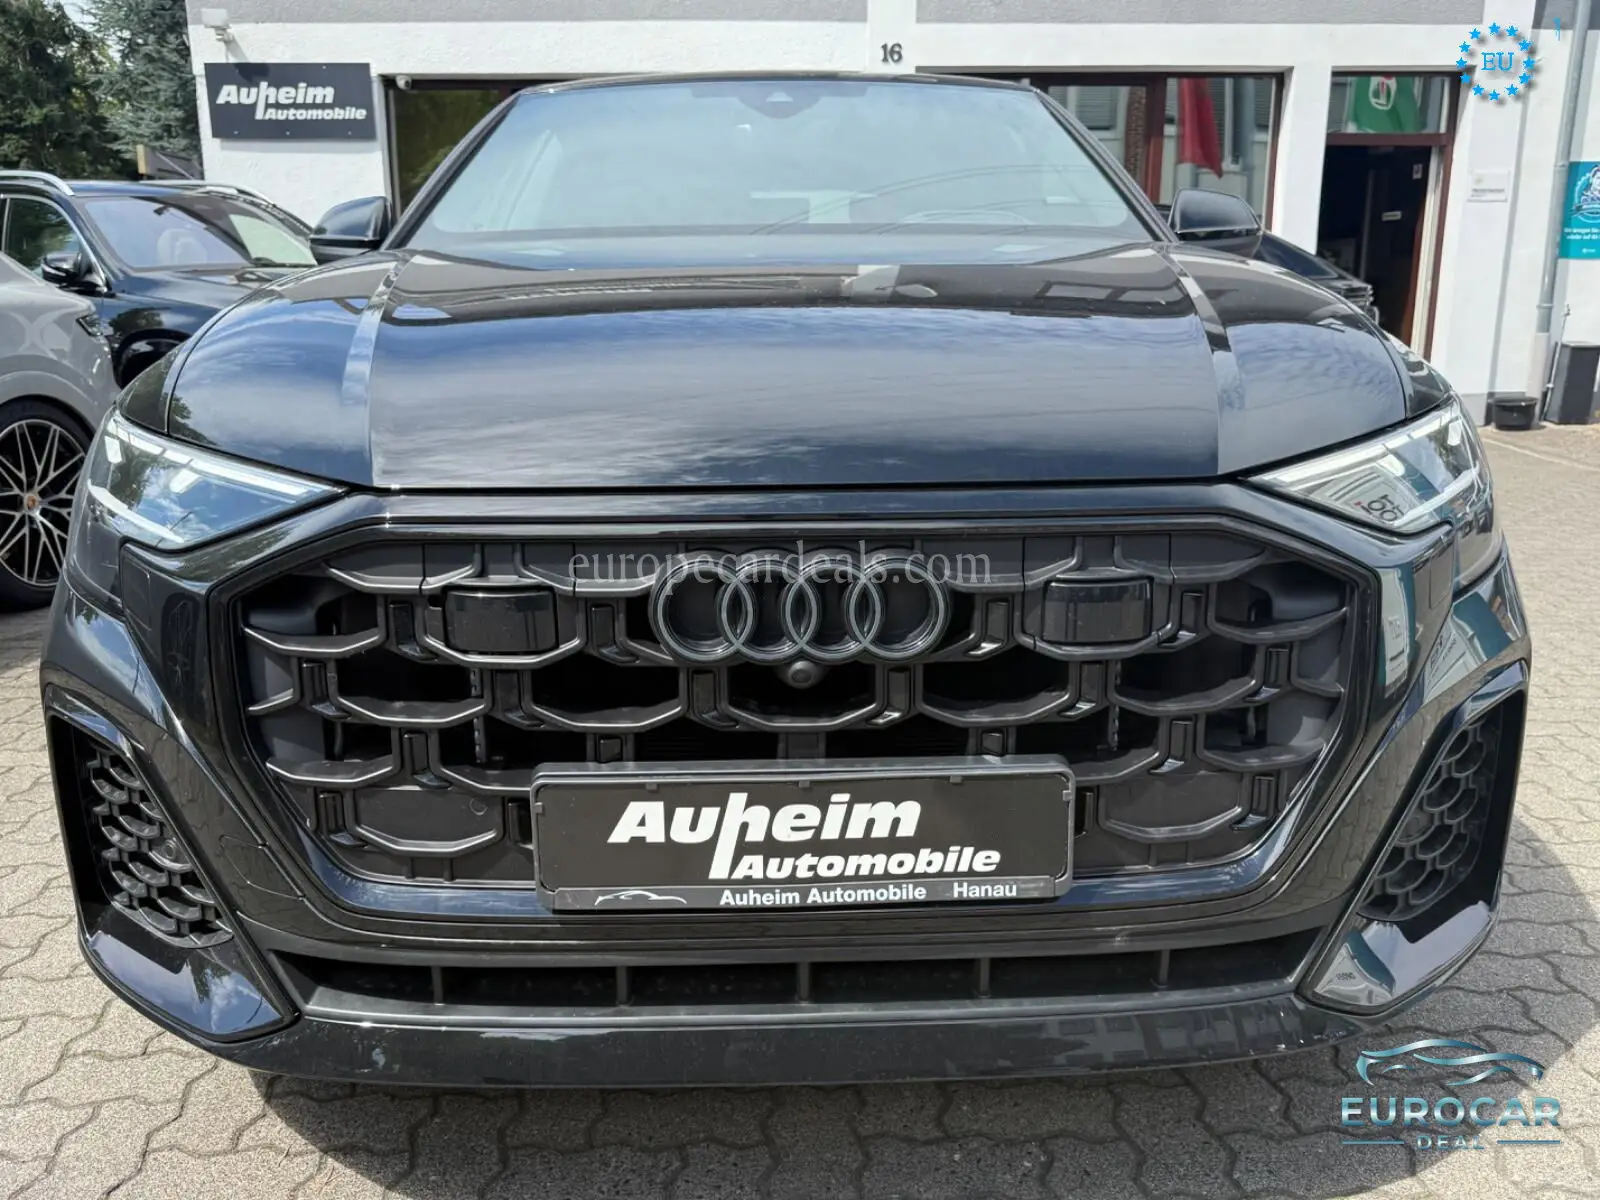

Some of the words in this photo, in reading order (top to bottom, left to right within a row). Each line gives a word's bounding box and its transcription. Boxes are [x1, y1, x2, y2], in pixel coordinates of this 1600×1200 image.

[881, 42, 903, 63] 16
[215, 81, 335, 120] Auheim
[264, 106, 367, 120] Automobile
[607, 792, 922, 880] Auheim
[732, 846, 1001, 880] Automobile
[719, 888, 800, 907] Auheim
[806, 884, 927, 904] Automobile
[952, 880, 1018, 899] Hanau
